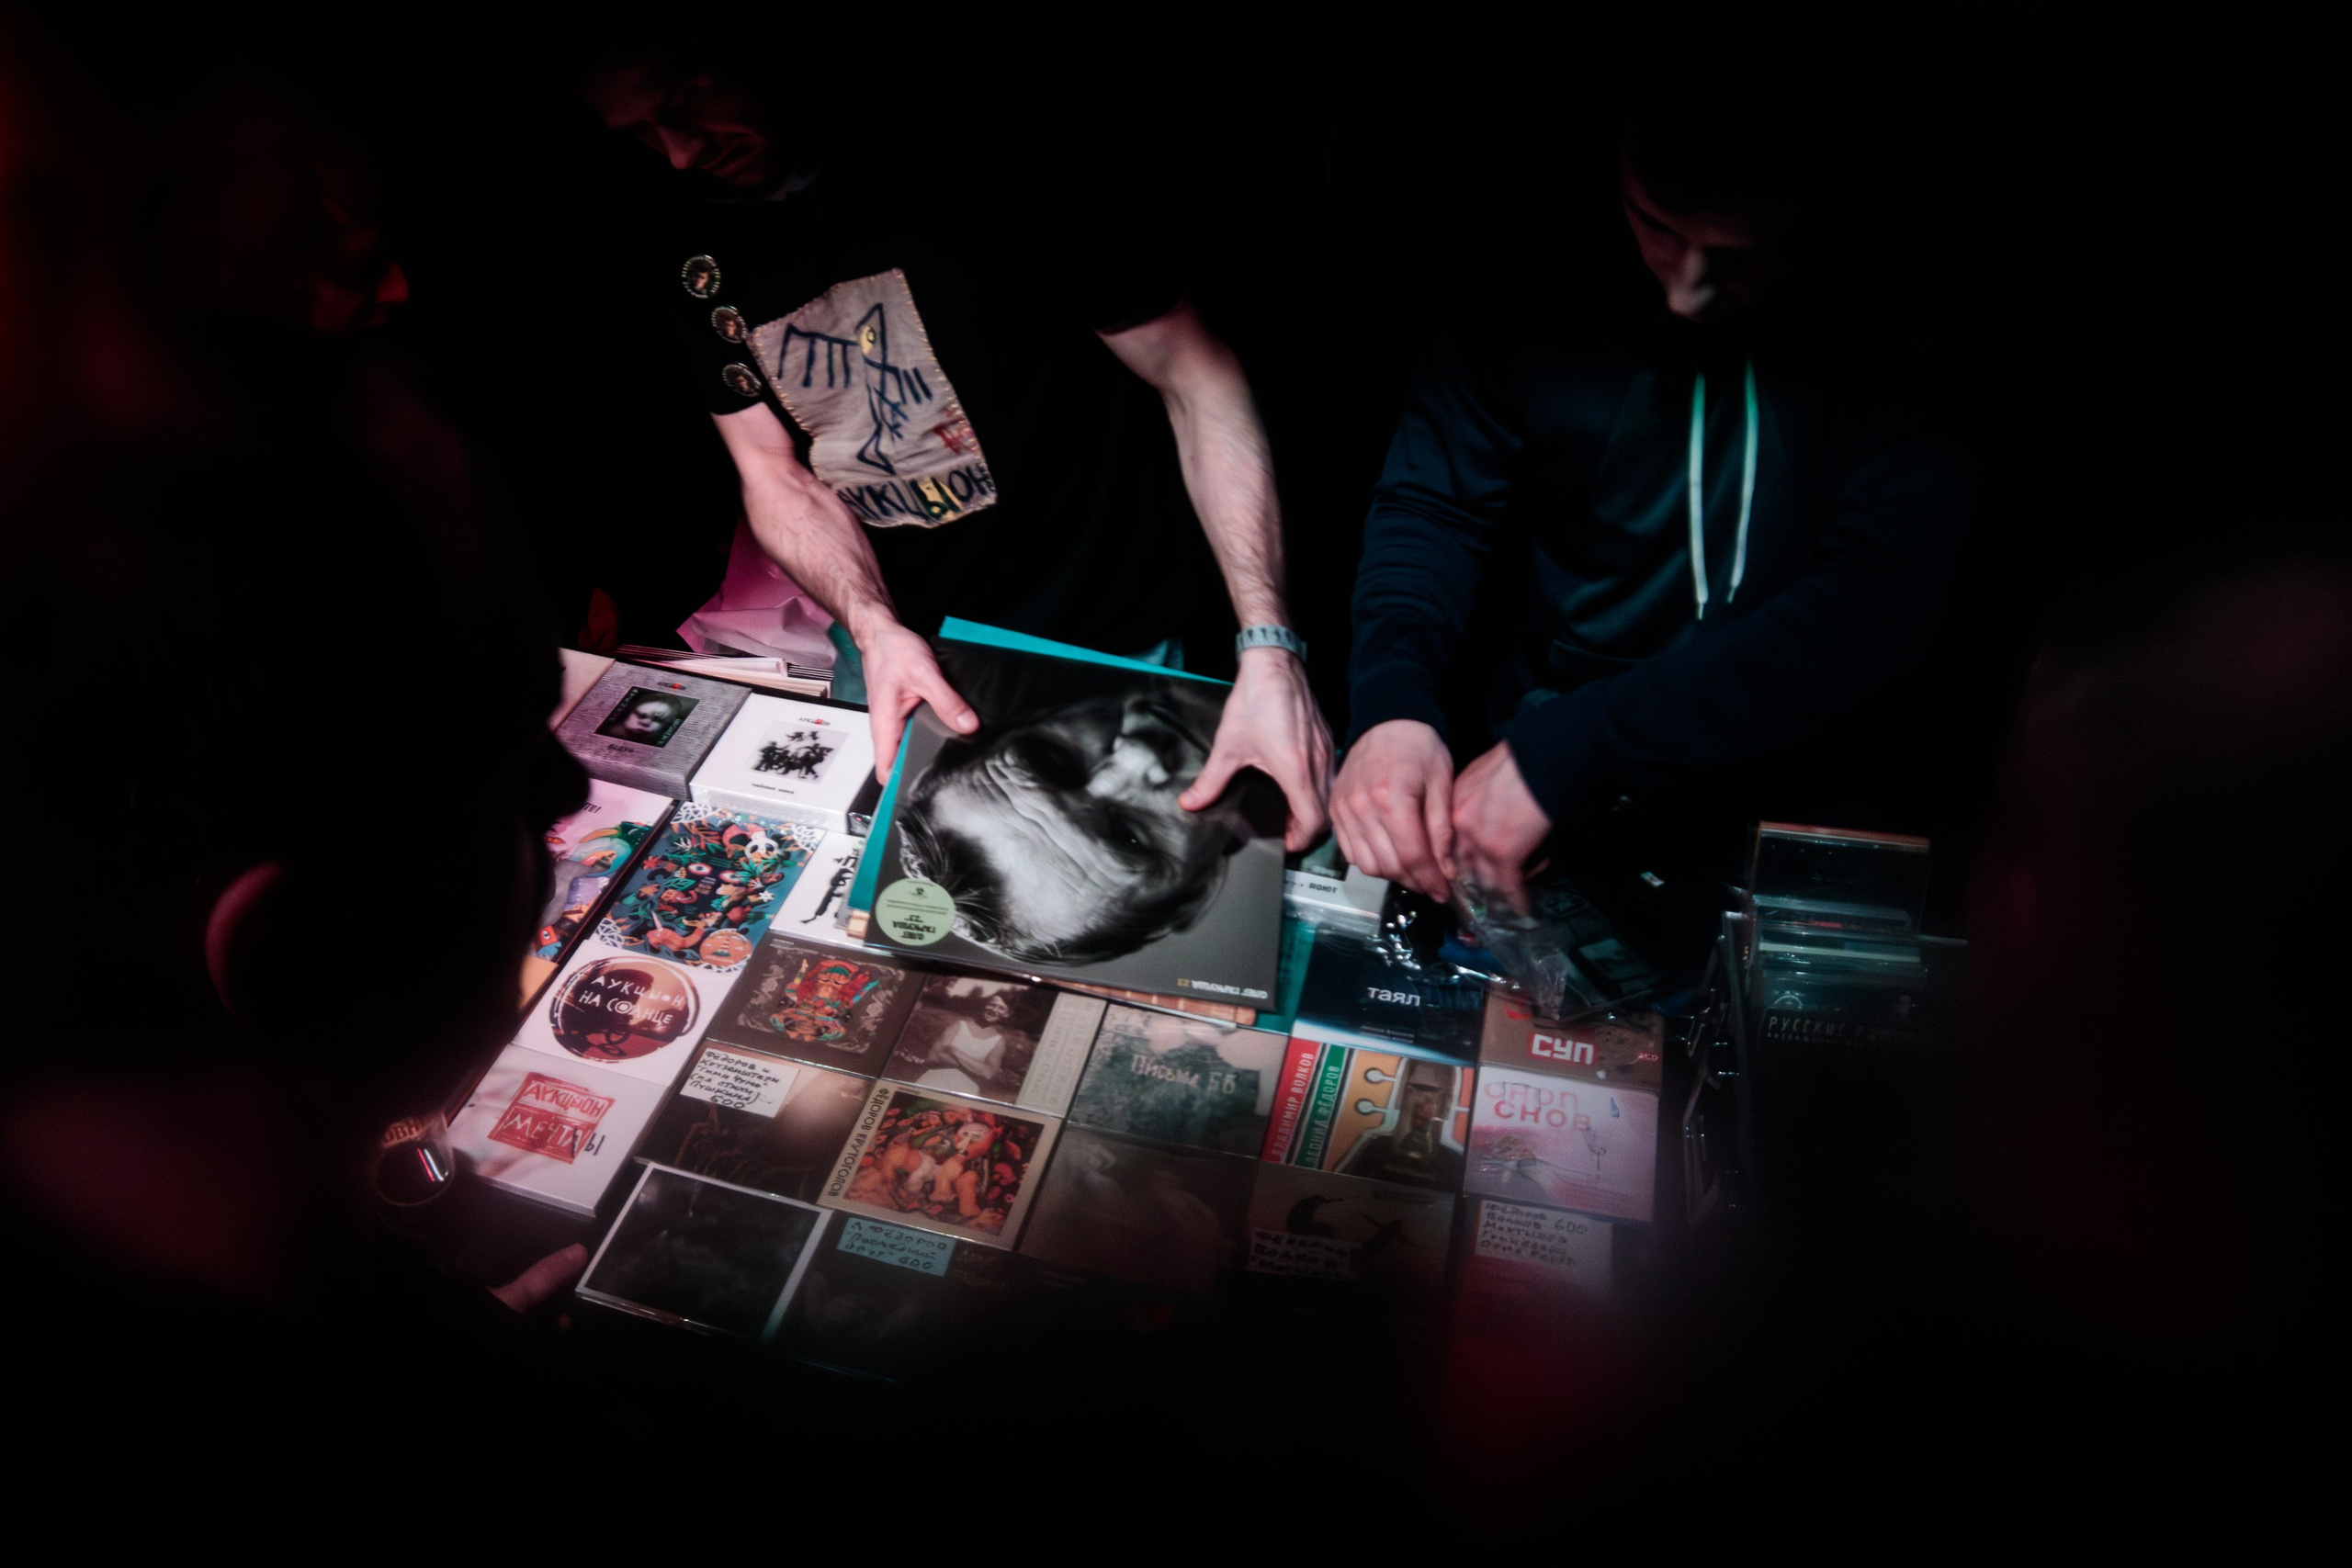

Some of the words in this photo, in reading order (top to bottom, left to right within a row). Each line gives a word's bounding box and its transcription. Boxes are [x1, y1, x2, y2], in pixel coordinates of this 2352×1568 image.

[578, 990, 601, 1007] НА
[1366, 985, 1421, 1008] таял
[1532, 1033, 1595, 1066] СУП
[1290, 1052, 1315, 1095] ВОЛКОВ
[524, 1083, 606, 1117] АУКЦЫОН
[1494, 1100, 1591, 1133] СНОВ
[1554, 1218, 1589, 1235] 600
